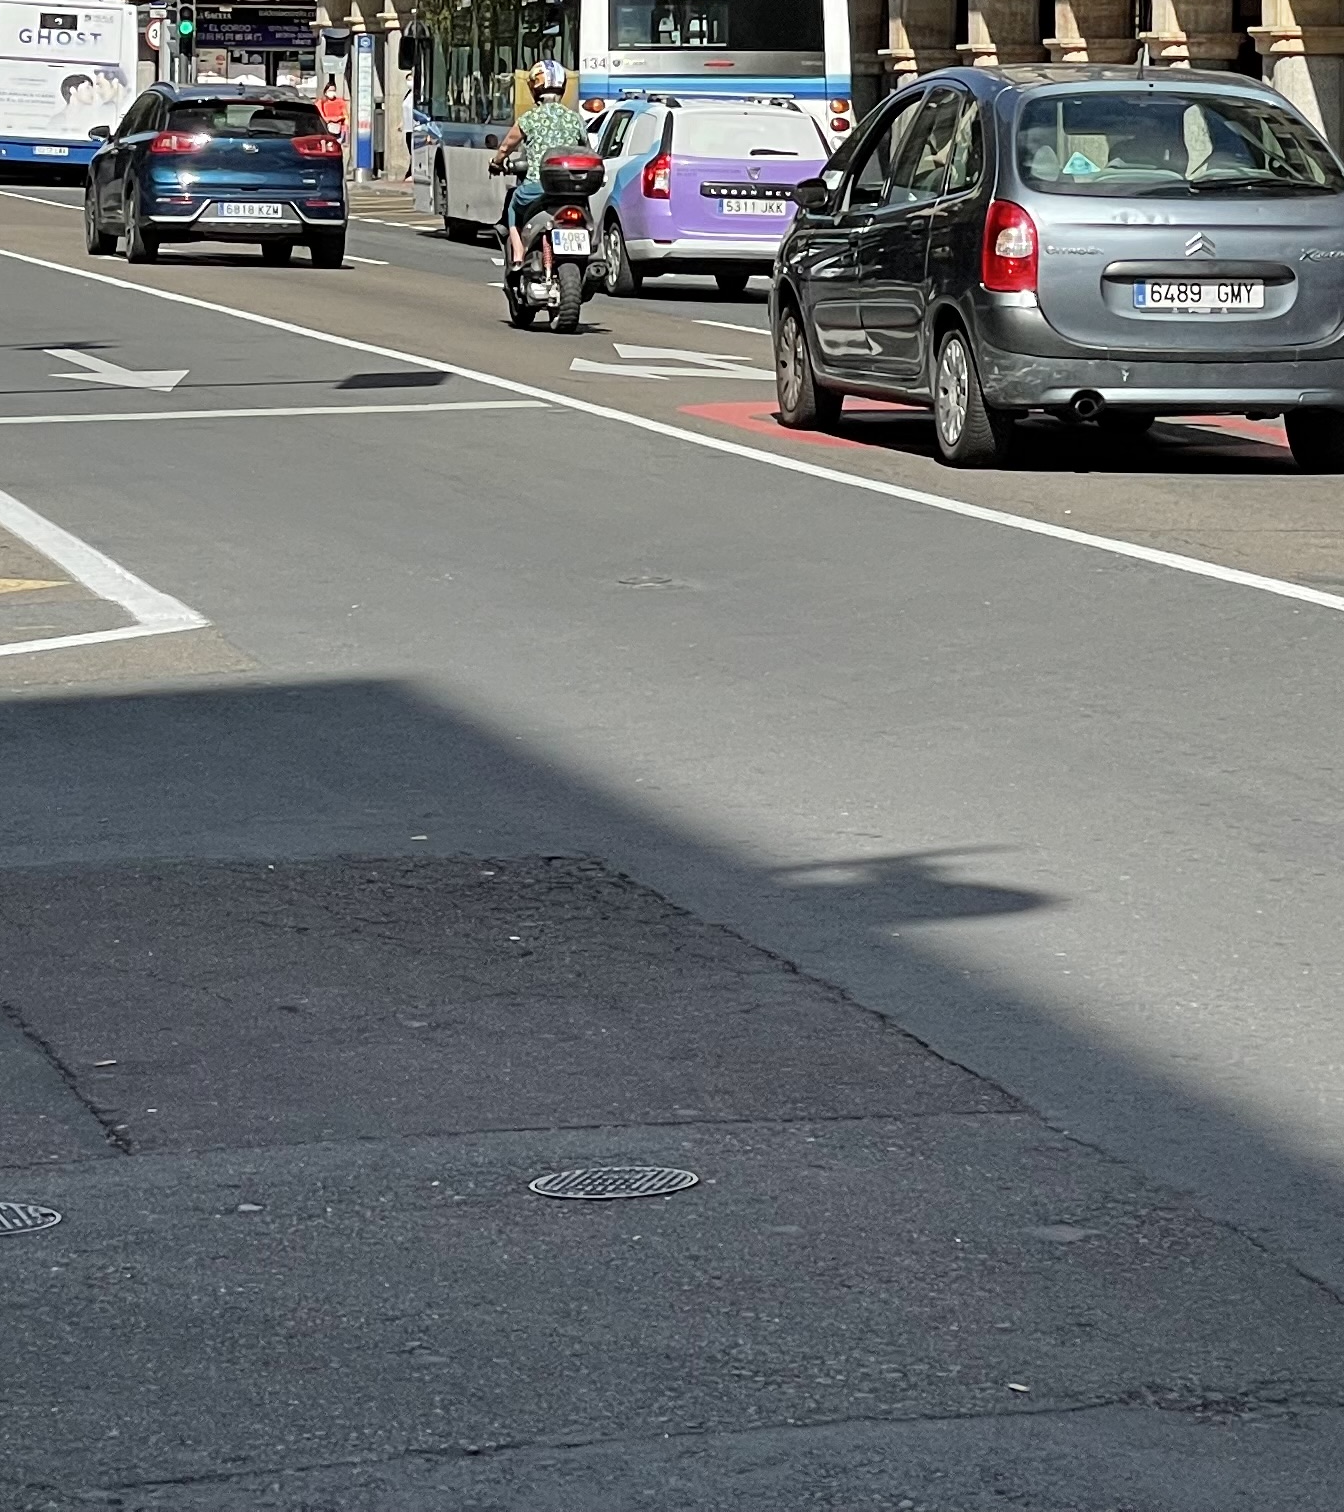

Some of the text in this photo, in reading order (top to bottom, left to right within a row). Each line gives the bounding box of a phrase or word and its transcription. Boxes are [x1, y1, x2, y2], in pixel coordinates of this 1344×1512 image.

[18, 28, 102, 46] GHOST
[582, 57, 608, 70] 134
[725, 200, 783, 214] 5311 JKK
[1150, 281, 1256, 304] 6489 GMY
